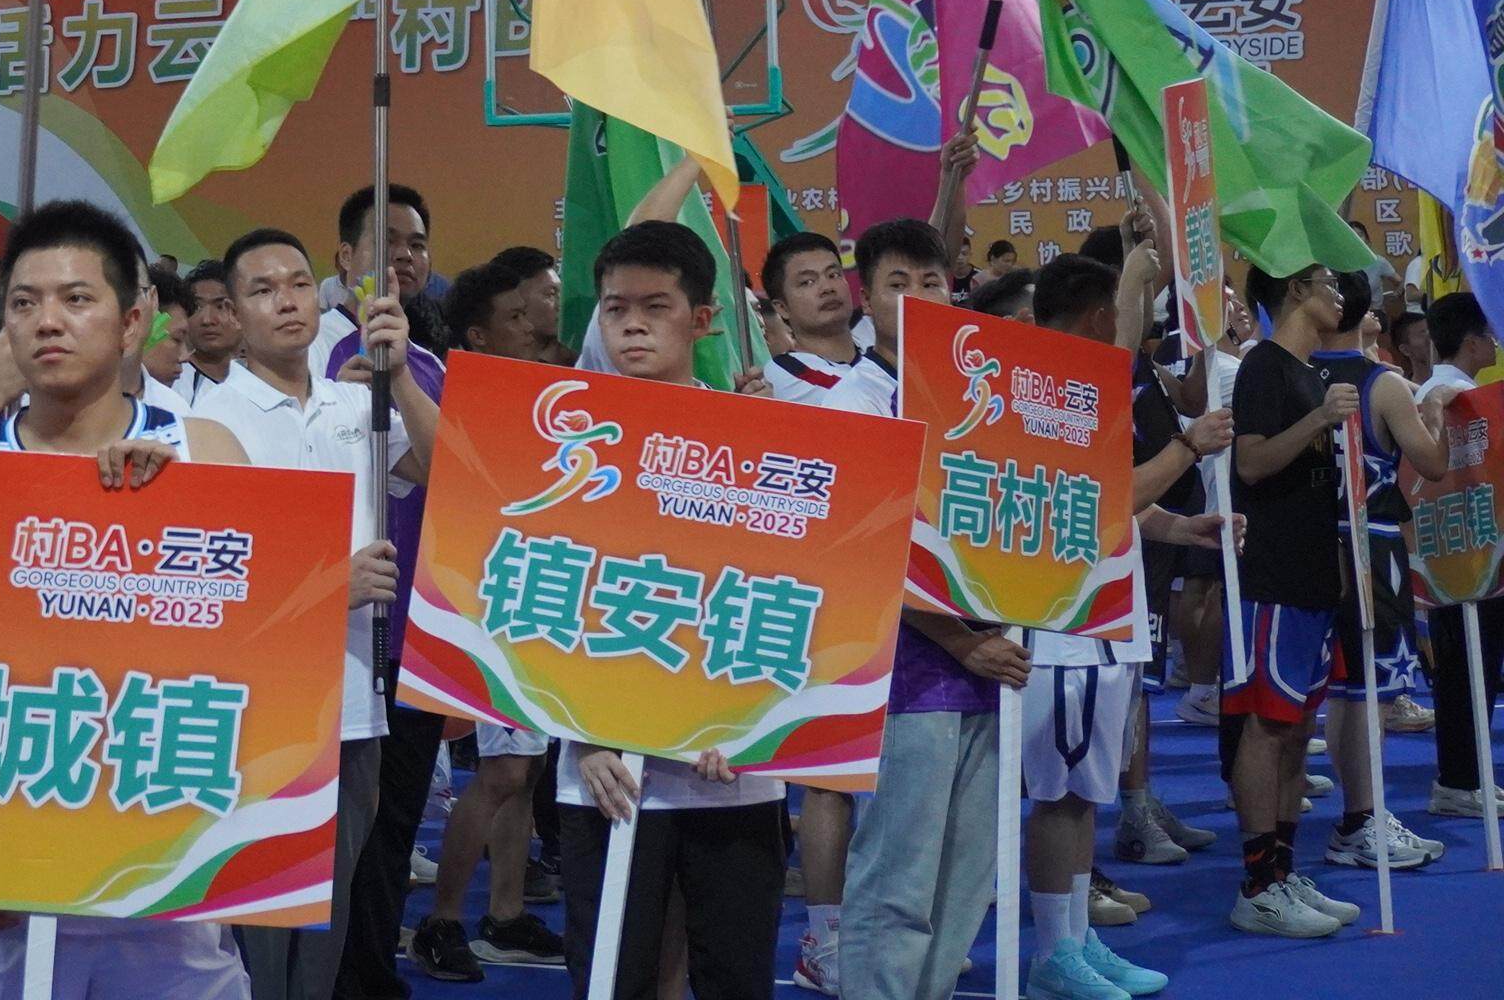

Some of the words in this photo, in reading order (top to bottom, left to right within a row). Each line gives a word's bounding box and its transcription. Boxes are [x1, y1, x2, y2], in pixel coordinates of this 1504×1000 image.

[1375, 199, 1402, 223] 区
[638, 474, 722, 500] GORGEOUS
[726, 488, 828, 517] COUNTRYSIDE
[940, 450, 1101, 567] 高村镇
[1413, 483, 1498, 559] 白石镇
[12, 569, 118, 593] GORGEOUS
[122, 576, 247, 600] COUNTRYSIDE
[479, 528, 824, 694] 镇安镇
